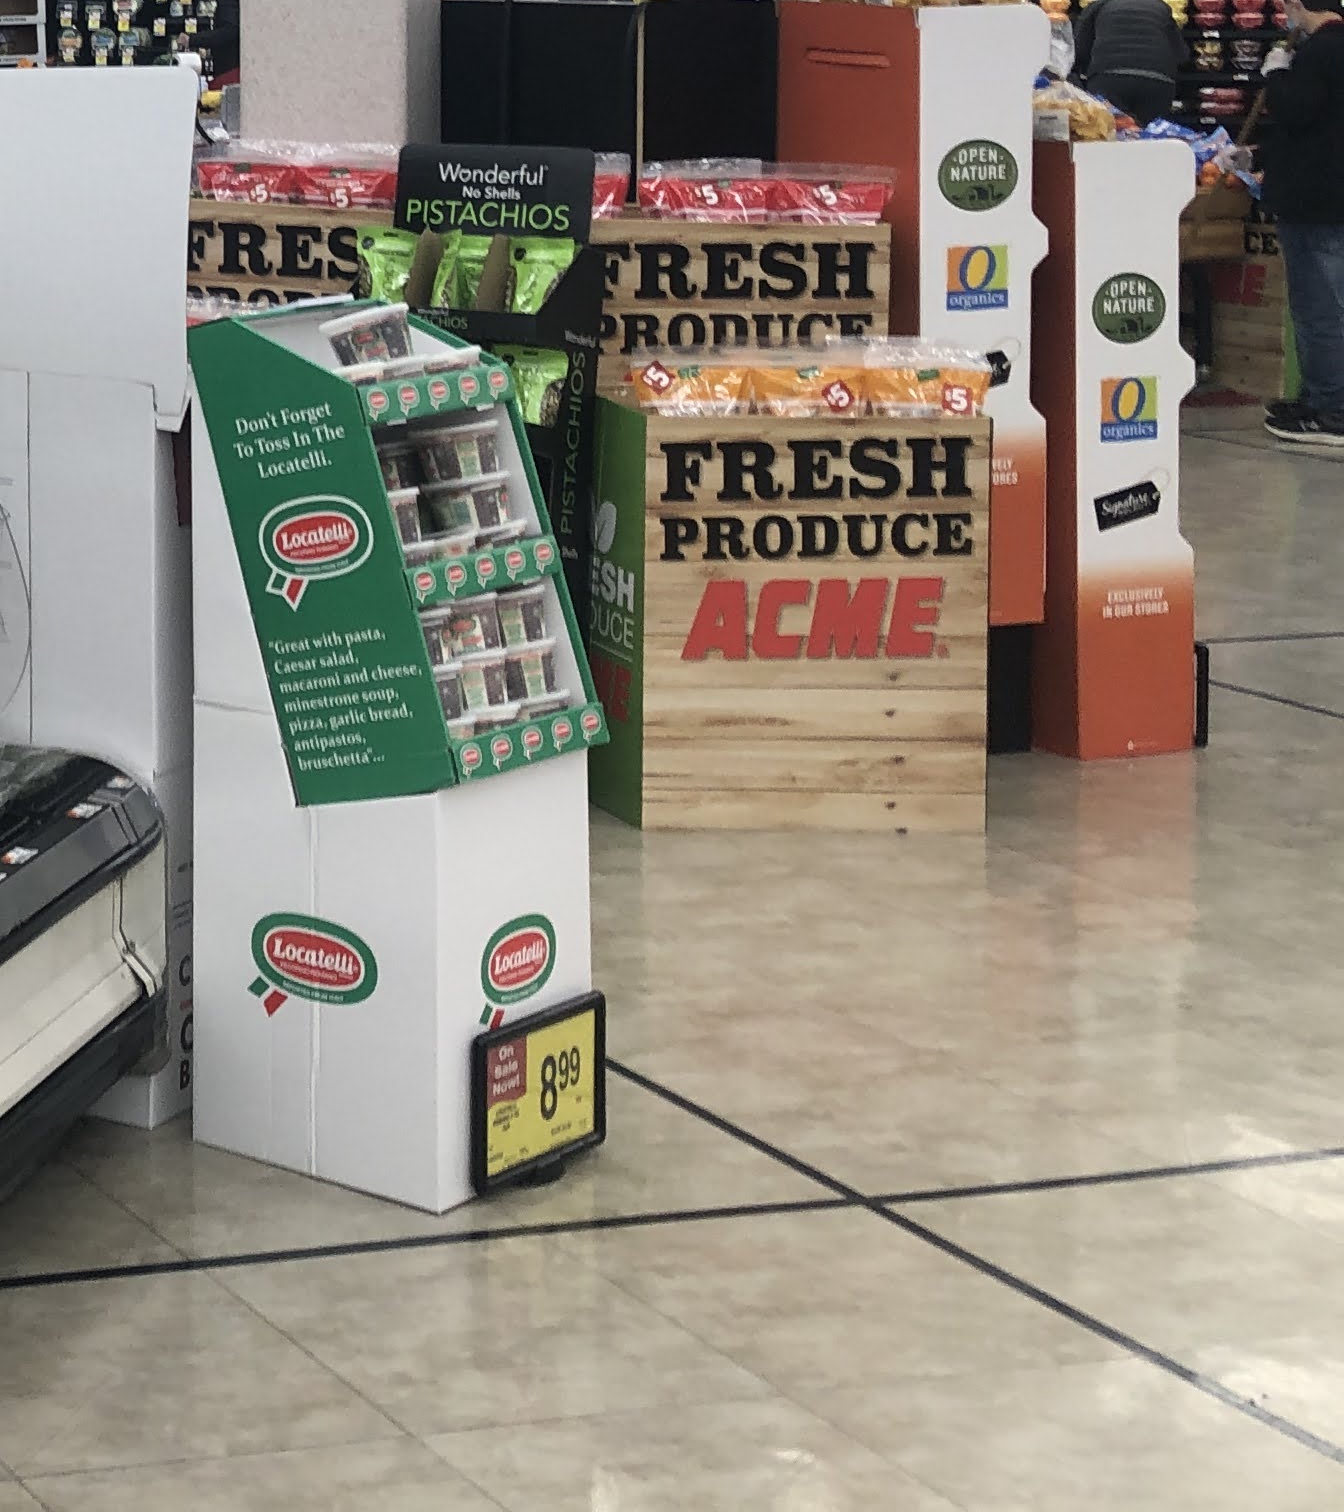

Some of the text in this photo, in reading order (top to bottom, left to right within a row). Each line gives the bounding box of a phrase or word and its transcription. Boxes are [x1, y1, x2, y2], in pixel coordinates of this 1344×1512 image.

[958, 148, 998, 165] OPEN
[439, 161, 545, 186] Wonderful
[950, 165, 1006, 181] NATURE
[463, 186, 521, 201] No Shells
[406, 199, 571, 231] PISTACHIOS
[188, 223, 359, 280] FRES
[600, 242, 876, 299] FRESH
[949, 293, 1005, 310] organics
[1109, 281, 1148, 297] OPEN
[1103, 297, 1155, 314] NATURE
[234, 401, 333, 438] Don't Forget
[1102, 424, 1156, 439] organics
[234, 423, 345, 461] To Toss In The
[561, 350, 585, 529] PISTACHIOS
[257, 451, 333, 482] Locatelli.
[660, 438, 974, 502] FRESH
[280, 520, 349, 551] Locatelli
[659, 513, 973, 561] PRODUCE
[1107, 586, 1164, 604] EXCLUSIVELY
[681, 576, 944, 660] ACME
[1103, 600, 1169, 619] IN OUR STORES
[312, 630, 343, 649] with
[345, 627, 386, 648] pasta,
[274, 648, 360, 675] Caesar salad,
[279, 663, 423, 694] macaroni and cheese,
[284, 688, 400, 714] minestrone soup,
[288, 701, 414, 737] pizza, garlic bread,
[294, 732, 367, 753] antipastos,
[273, 935, 357, 976] Locatelli
[494, 938, 545, 976] Locatelli
[498, 1044, 515, 1062] On
[492, 1074, 520, 1097] Now!
